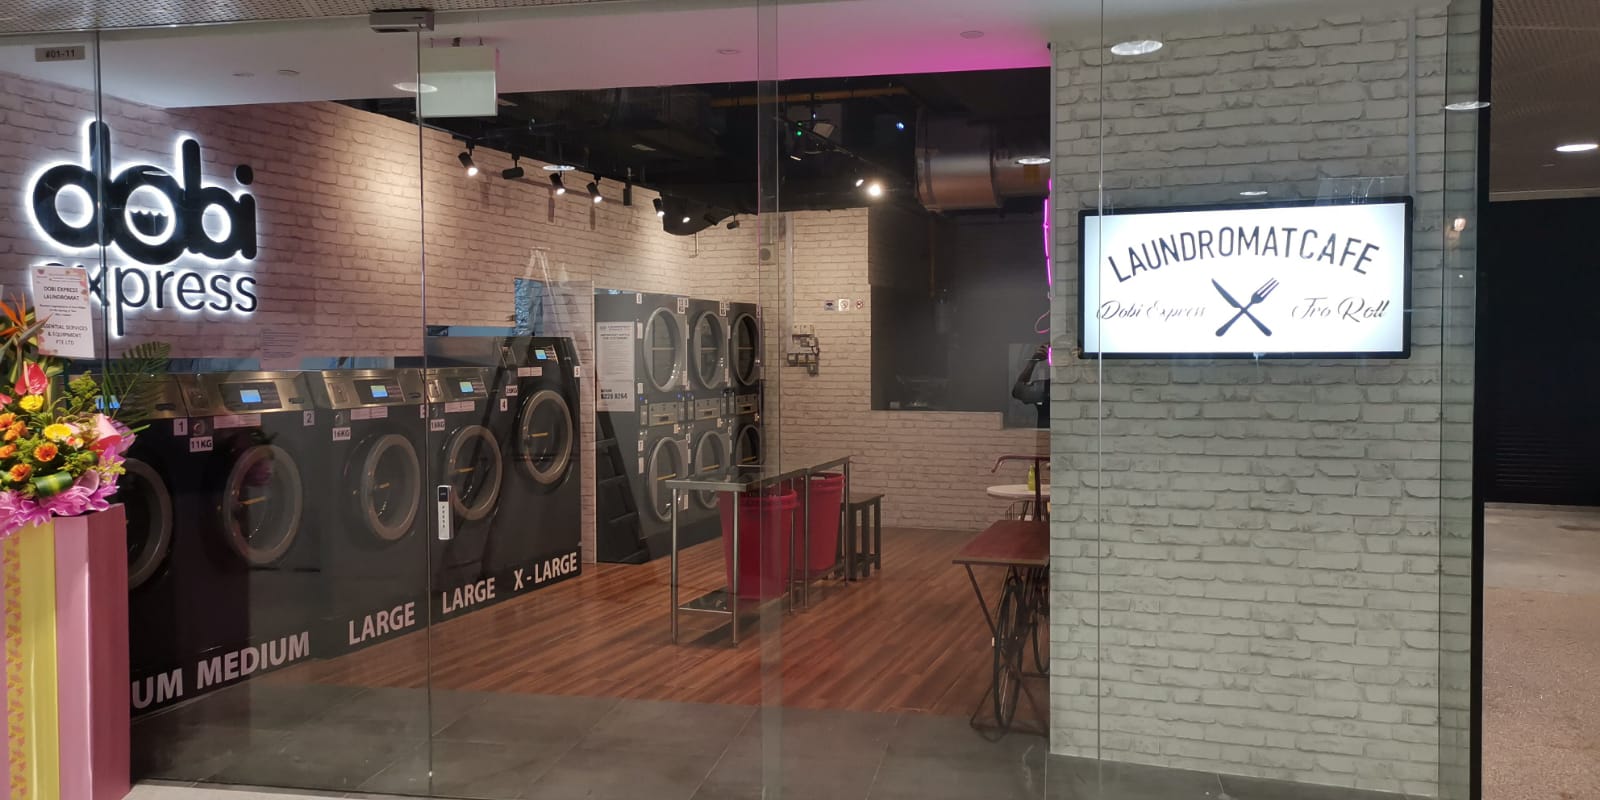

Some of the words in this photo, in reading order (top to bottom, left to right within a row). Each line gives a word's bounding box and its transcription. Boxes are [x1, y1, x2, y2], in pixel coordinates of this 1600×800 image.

[33, 120, 257, 265] dobi
[45, 262, 257, 336] xpress
[1096, 299, 1142, 320] Dobi
[1337, 296, 1390, 322] Roll
[306, 413, 313, 424] 2
[191, 439, 212, 449] 11KG
[442, 577, 496, 614] LARGE
[349, 602, 415, 645] LARGE
[197, 631, 310, 690] MEDIUM
